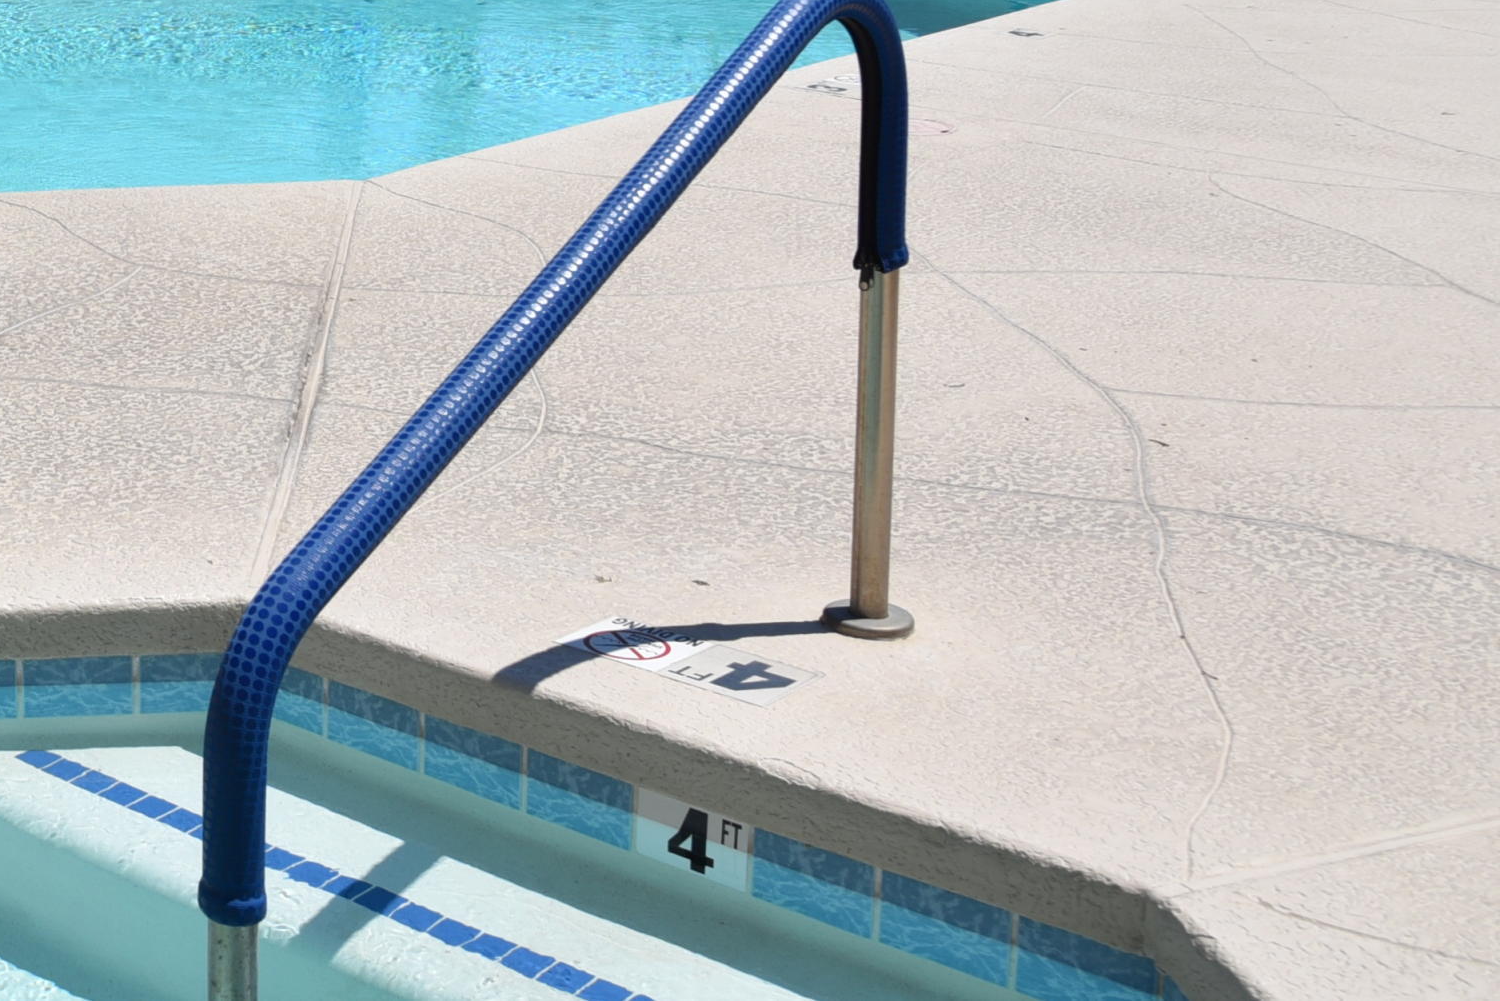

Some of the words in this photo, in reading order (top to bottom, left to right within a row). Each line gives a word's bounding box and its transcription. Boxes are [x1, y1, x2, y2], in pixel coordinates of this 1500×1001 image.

[611, 617, 675, 640] DIVING
[674, 635, 704, 648] NO
[667, 665, 714, 682] FT
[709, 659, 797, 692] 4
[667, 806, 715, 875] 4
[720, 818, 743, 850] FT
